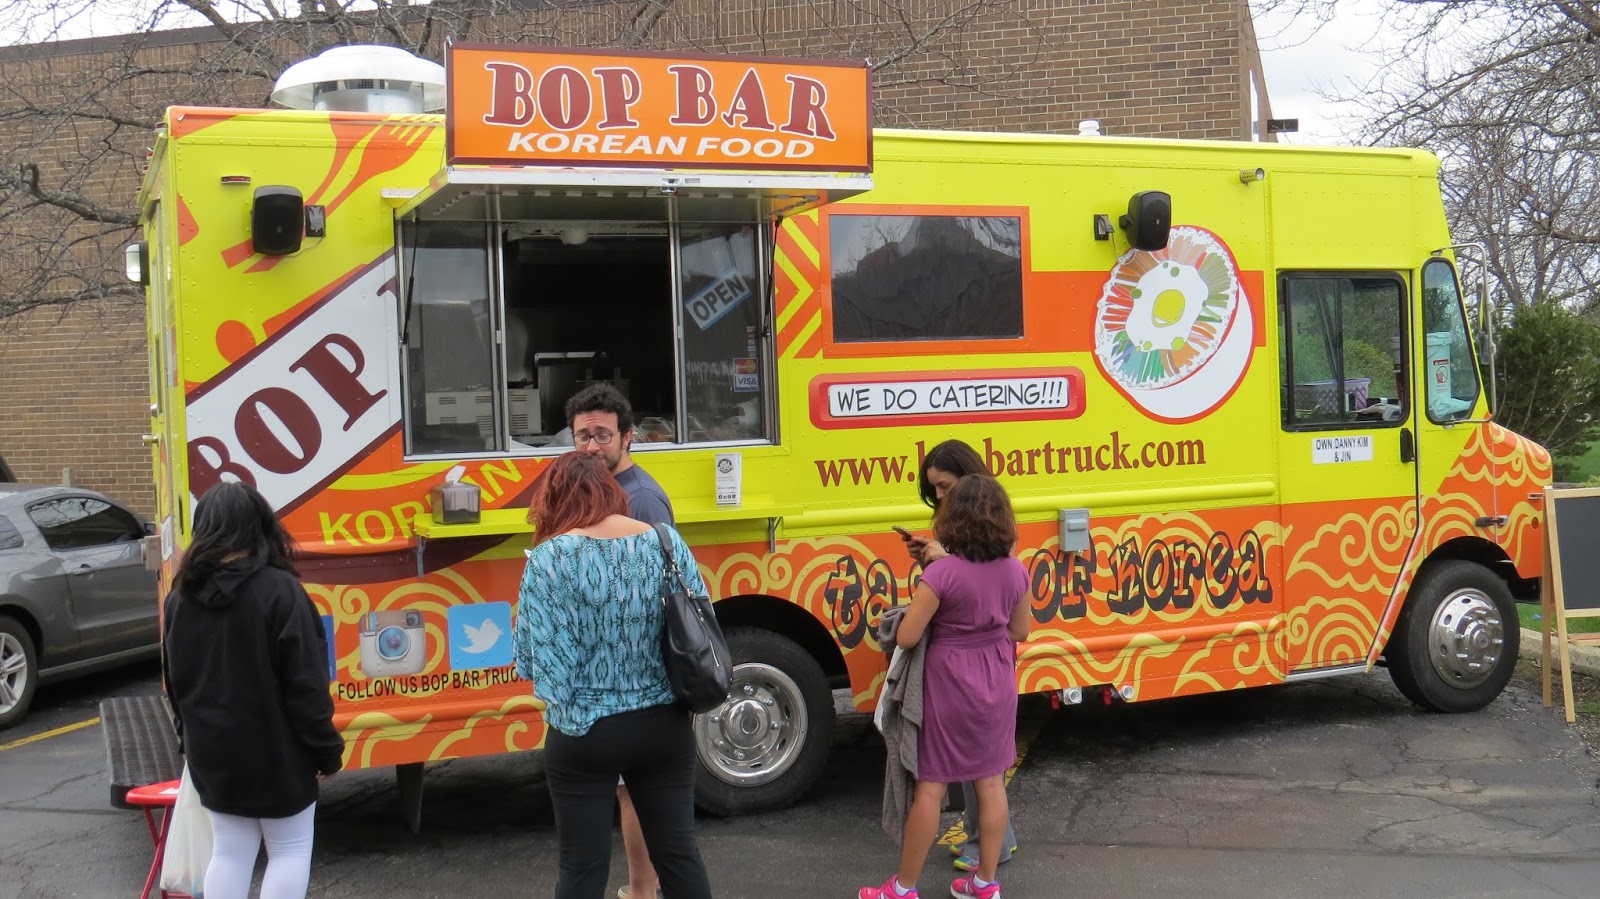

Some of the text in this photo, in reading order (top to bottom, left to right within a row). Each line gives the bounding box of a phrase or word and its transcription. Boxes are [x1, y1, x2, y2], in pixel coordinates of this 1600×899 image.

[483, 61, 836, 141] BOP BAR
[507, 132, 815, 158] KOREAN FOOD
[692, 276, 746, 322] OPEN
[738, 377, 757, 386] VISA
[837, 381, 1063, 412] WE DO CATERING!!!
[1357, 436, 1368, 447] KIM
[1334, 451, 1351, 462] & JIN
[338, 666, 528, 700] FOLLOW US BOP BAR TRUC
